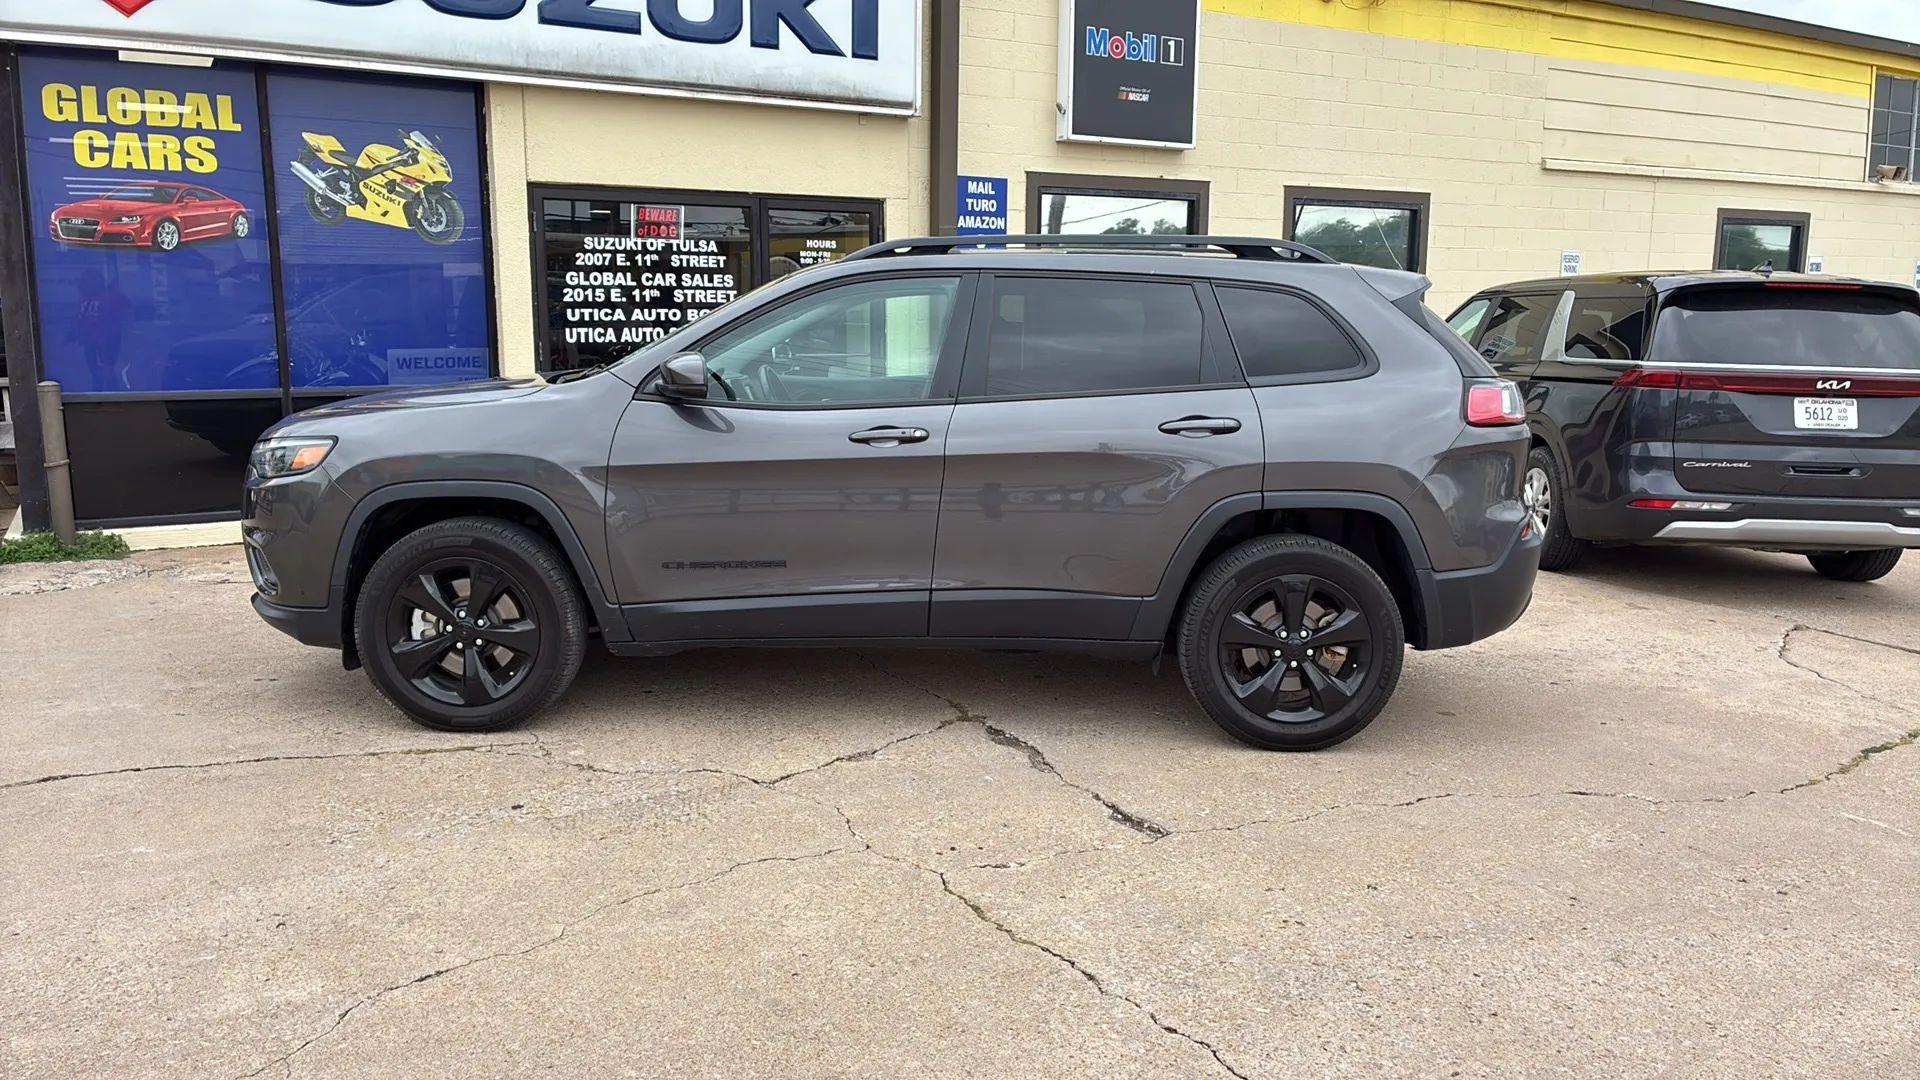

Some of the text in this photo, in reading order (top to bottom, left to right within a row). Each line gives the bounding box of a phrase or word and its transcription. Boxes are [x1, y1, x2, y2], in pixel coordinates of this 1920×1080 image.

[1086, 26, 1157, 63] Mobil
[41, 82, 242, 132] GLOBAL
[72, 129, 218, 173] CARS
[362, 181, 402, 206] SUZUKI
[967, 180, 996, 195] MAIL
[965, 198, 998, 212] TURO
[638, 208, 678, 222] BEWARE
[957, 215, 1006, 230] AMAZON
[637, 225, 677, 237] of DOG
[583, 236, 718, 253] SUZUKI OF TULSA
[806, 239, 837, 249] HOURS
[575, 252, 727, 268] 2007 E. 11th STREET
[565, 271, 734, 288] GLOBAL CAR SALES
[562, 288, 737, 303] 2015 E. 11th STREET
[566, 308, 626, 321] UTICA
[631, 308, 682, 321] AUTO
[565, 327, 617, 343] UTICA
[620, 327, 664, 343] AUTO
[396, 356, 482, 369] WELCOME
[1816, 380, 1851, 389] KIA
[1805, 406, 1833, 420] 5612
[661, 560, 787, 569] CHEROKEE
